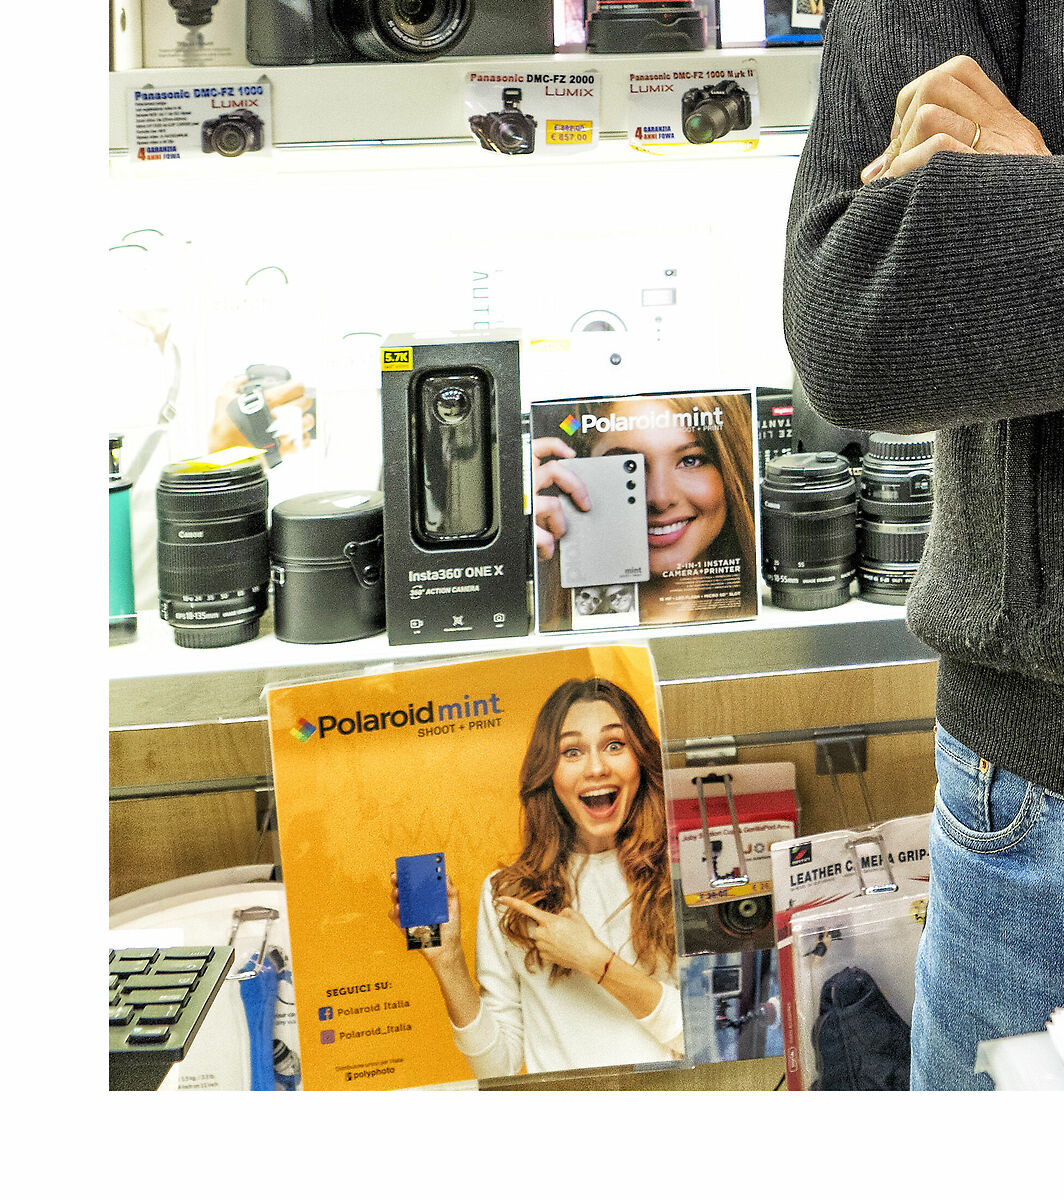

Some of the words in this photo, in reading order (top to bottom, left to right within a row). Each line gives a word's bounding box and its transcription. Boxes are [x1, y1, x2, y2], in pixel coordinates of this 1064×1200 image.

[470, 73, 524, 84] Panasonic
[526, 74, 566, 84] DMC-FZ
[569, 74, 595, 84] 2000
[134, 89, 190, 100] Panasonic
[193, 87, 235, 98] DMC-FZ
[238, 86, 264, 96] 1000
[545, 85, 594, 97] LUMIX
[629, 83, 674, 94] LUMIX
[211, 99, 258, 109] LUMIX
[635, 126, 643, 140] 4
[385, 351, 408, 363] 5.7K
[581, 409, 670, 434] Polaroid
[672, 406, 724, 427] mint
[676, 561, 702, 571] 2-IN-1
[704, 558, 741, 568] INSTANT
[409, 567, 463, 582] Insta360
[465, 566, 492, 578] ONE
[493, 564, 505, 577] X
[317, 701, 434, 739] Polaroid
[438, 693, 502, 721] mint
[417, 725, 455, 739] SHOOT
[468, 718, 502, 730] PRINT
[789, 861, 843, 887] LEATHER
[326, 983, 372, 998] SEGUICI
[374, 981, 393, 993] SU:
[337, 1003, 380, 1018] Polaroid
[383, 998, 410, 1010] Italia
[338, 1023, 412, 1041] Polaroid_Italia
[353, 1066, 396, 1081] polyphoto
